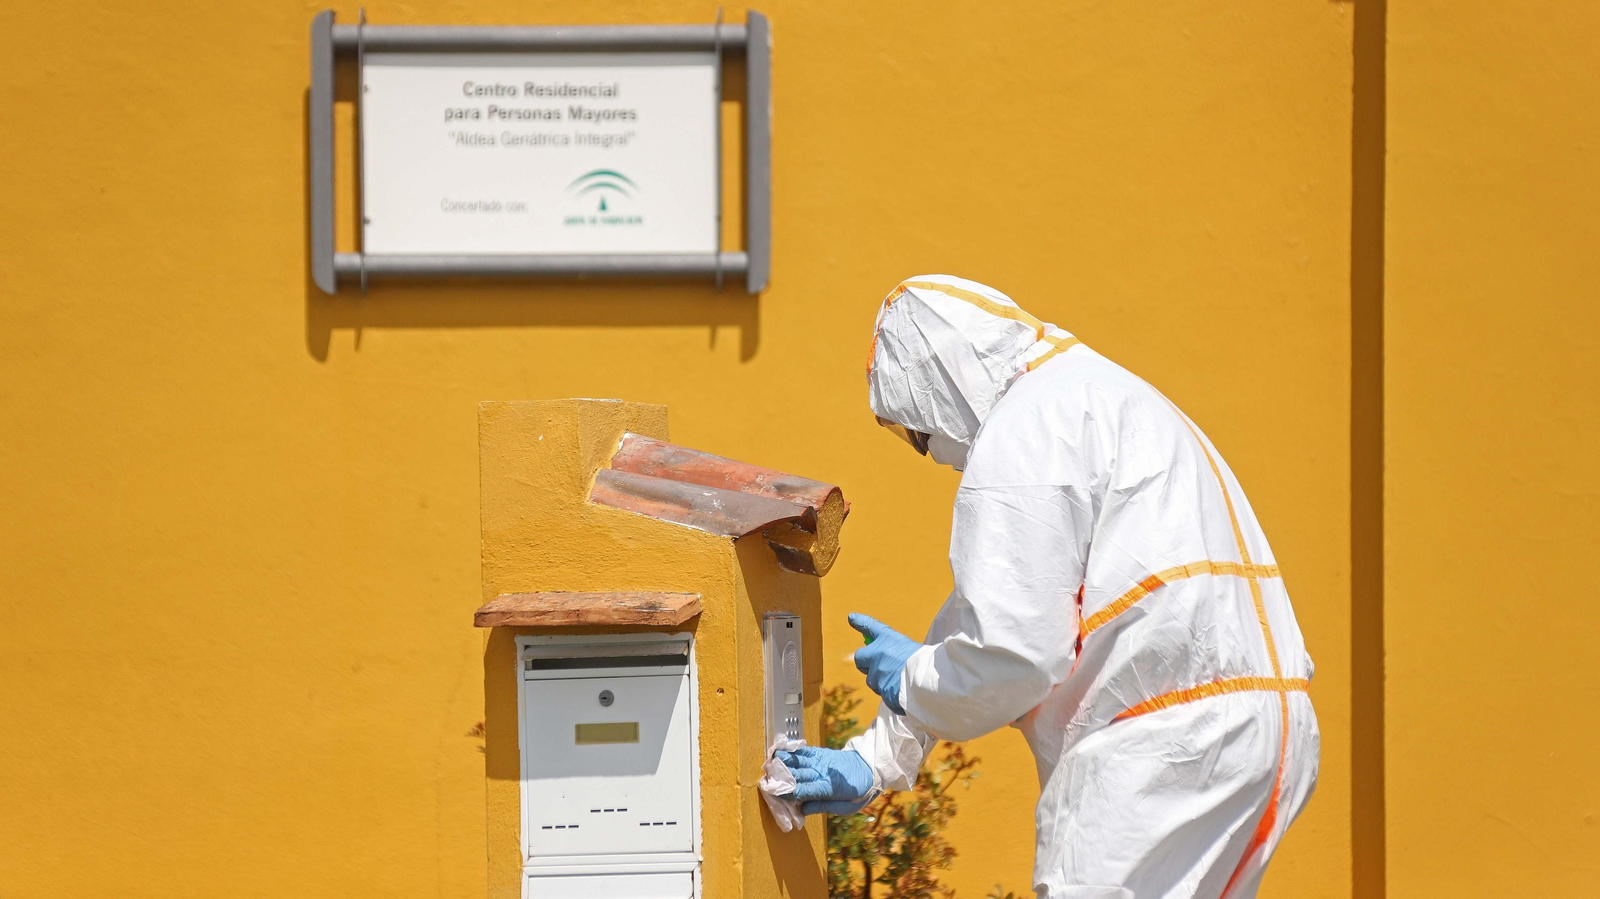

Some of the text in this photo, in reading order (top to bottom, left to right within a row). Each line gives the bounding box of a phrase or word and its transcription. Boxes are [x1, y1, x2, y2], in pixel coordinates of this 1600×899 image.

[462, 80, 618, 98] Centro Residencial
[444, 104, 637, 124] para Personas Mayores
[500, 131, 569, 146] Geriátrica
[440, 197, 502, 212] Concertado
